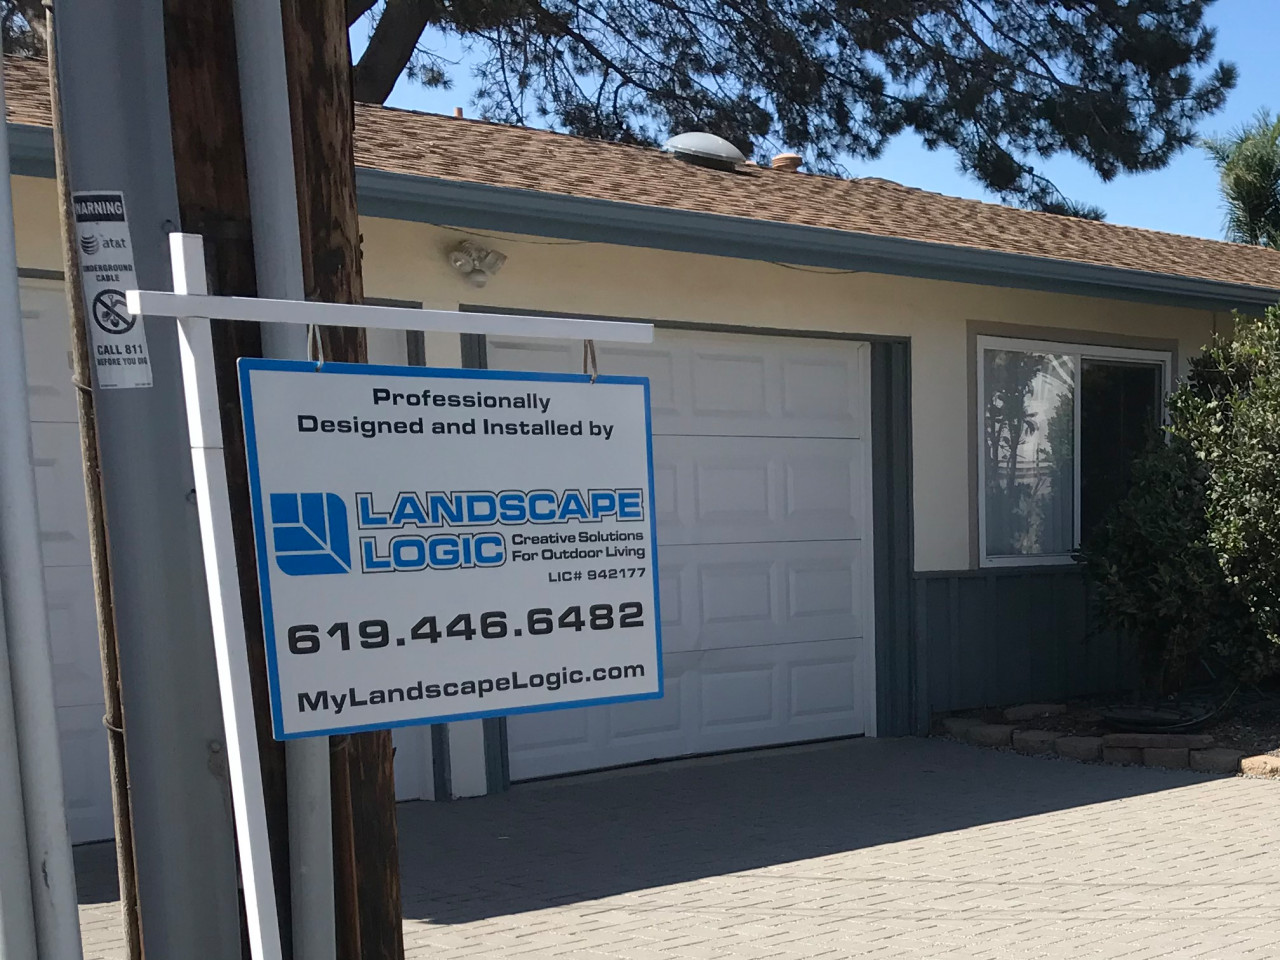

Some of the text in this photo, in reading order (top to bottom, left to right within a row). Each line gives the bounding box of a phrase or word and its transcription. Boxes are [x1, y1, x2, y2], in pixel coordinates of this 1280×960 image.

[74, 201, 123, 215] WARNING
[102, 237, 126, 249] at&t
[96, 274, 120, 282] CABLE
[97, 344, 143, 355] CALL 811
[97, 358, 121, 366] BEFORE
[138, 357, 148, 365] DIG
[373, 388, 551, 413] Professionally
[297, 415, 614, 440] Designed and Installed by
[356, 488, 644, 530] LANDSCAPE
[512, 531, 644, 546] Creative Solutions
[360, 533, 507, 573] LOGIC
[512, 545, 646, 562] For Outdoor Living
[548, 568, 646, 583] LIC# 942177
[287, 601, 644, 655] 619.446.6482
[297, 663, 645, 714] MyLandscapeLogic.com
